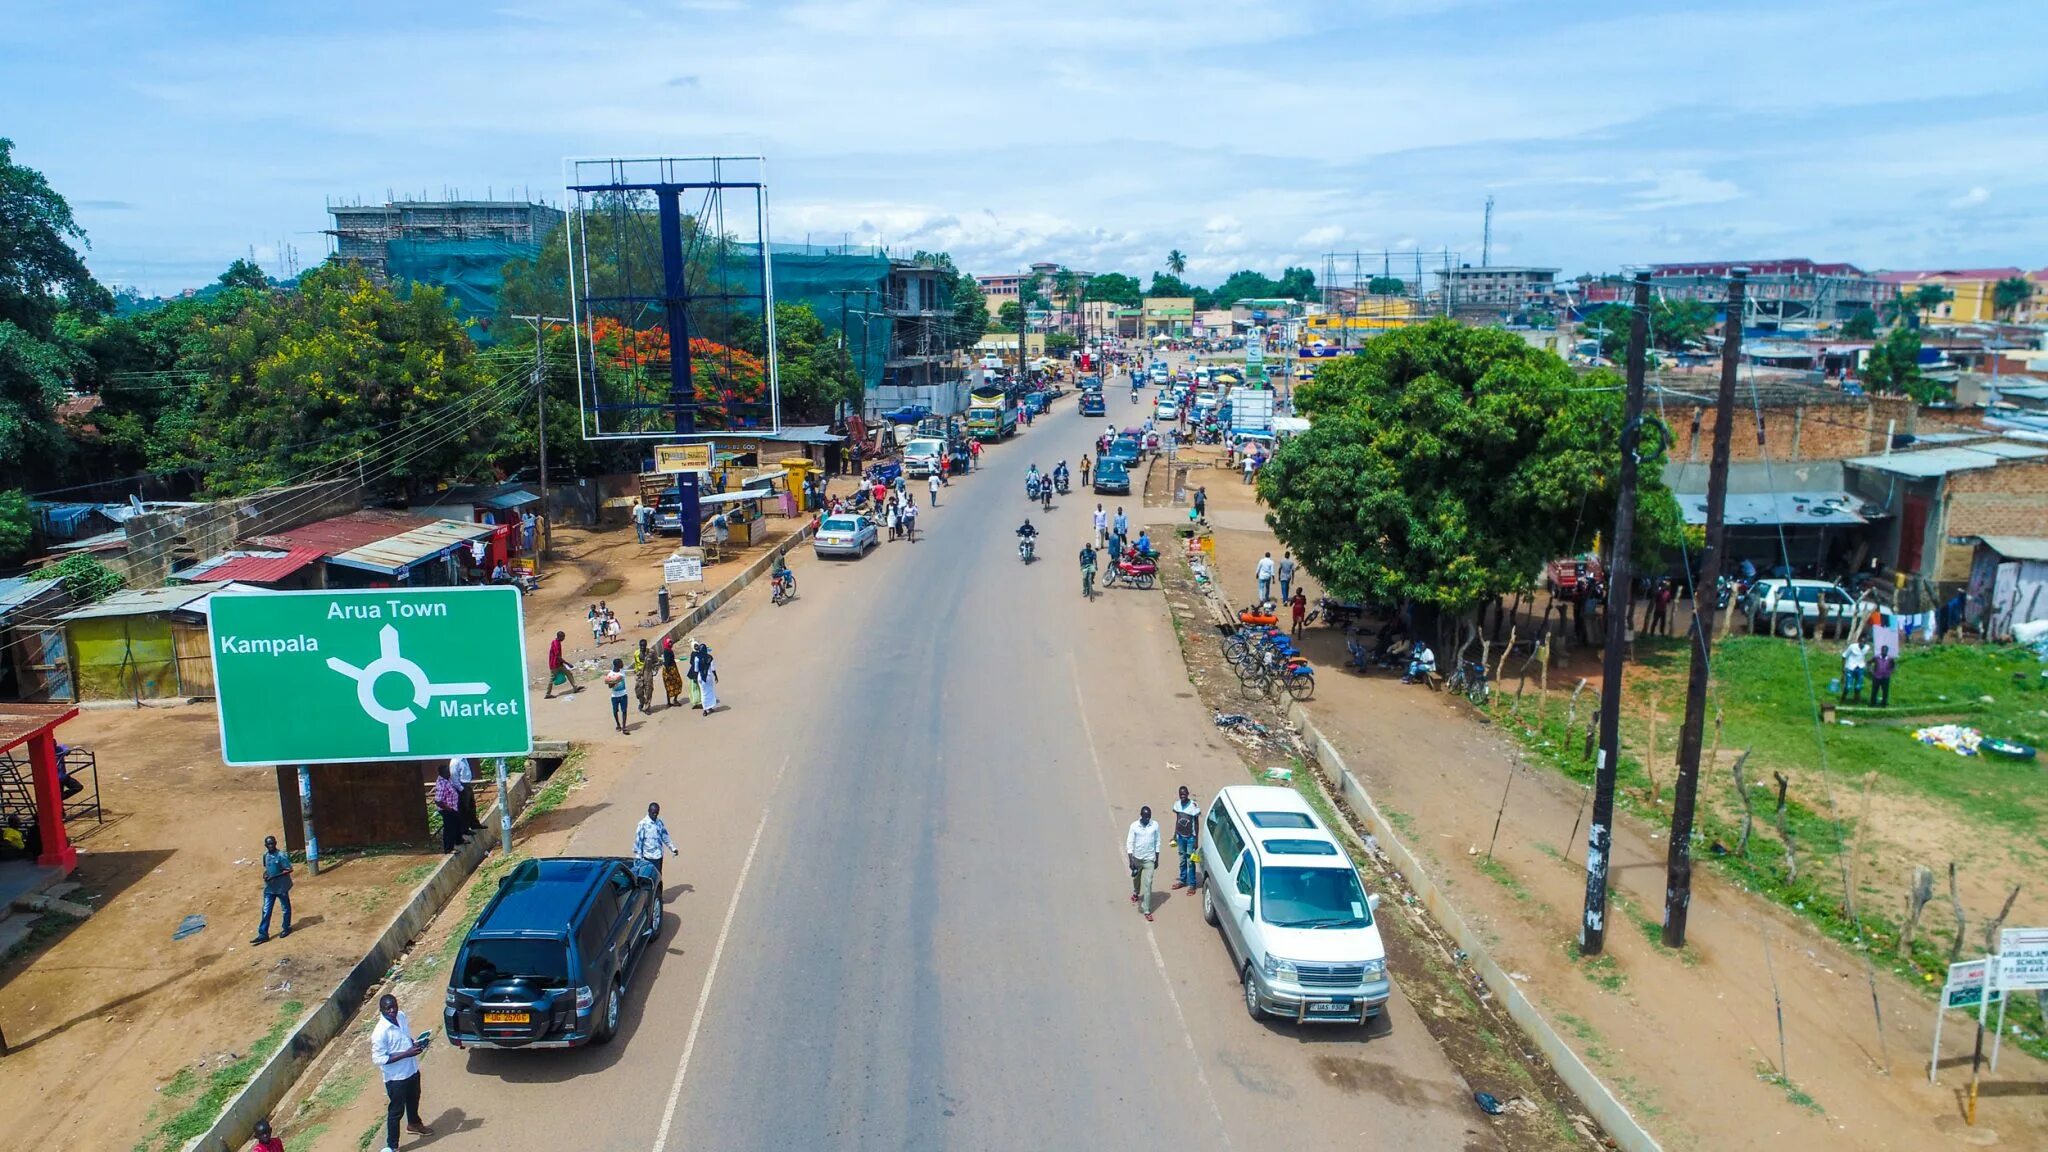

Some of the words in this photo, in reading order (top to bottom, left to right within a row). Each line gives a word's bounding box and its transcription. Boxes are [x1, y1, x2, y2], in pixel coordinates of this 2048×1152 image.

[327, 601, 381, 619] Arua
[386, 600, 447, 618] Town
[221, 634, 318, 657] Kampala
[440, 699, 518, 718] Market
